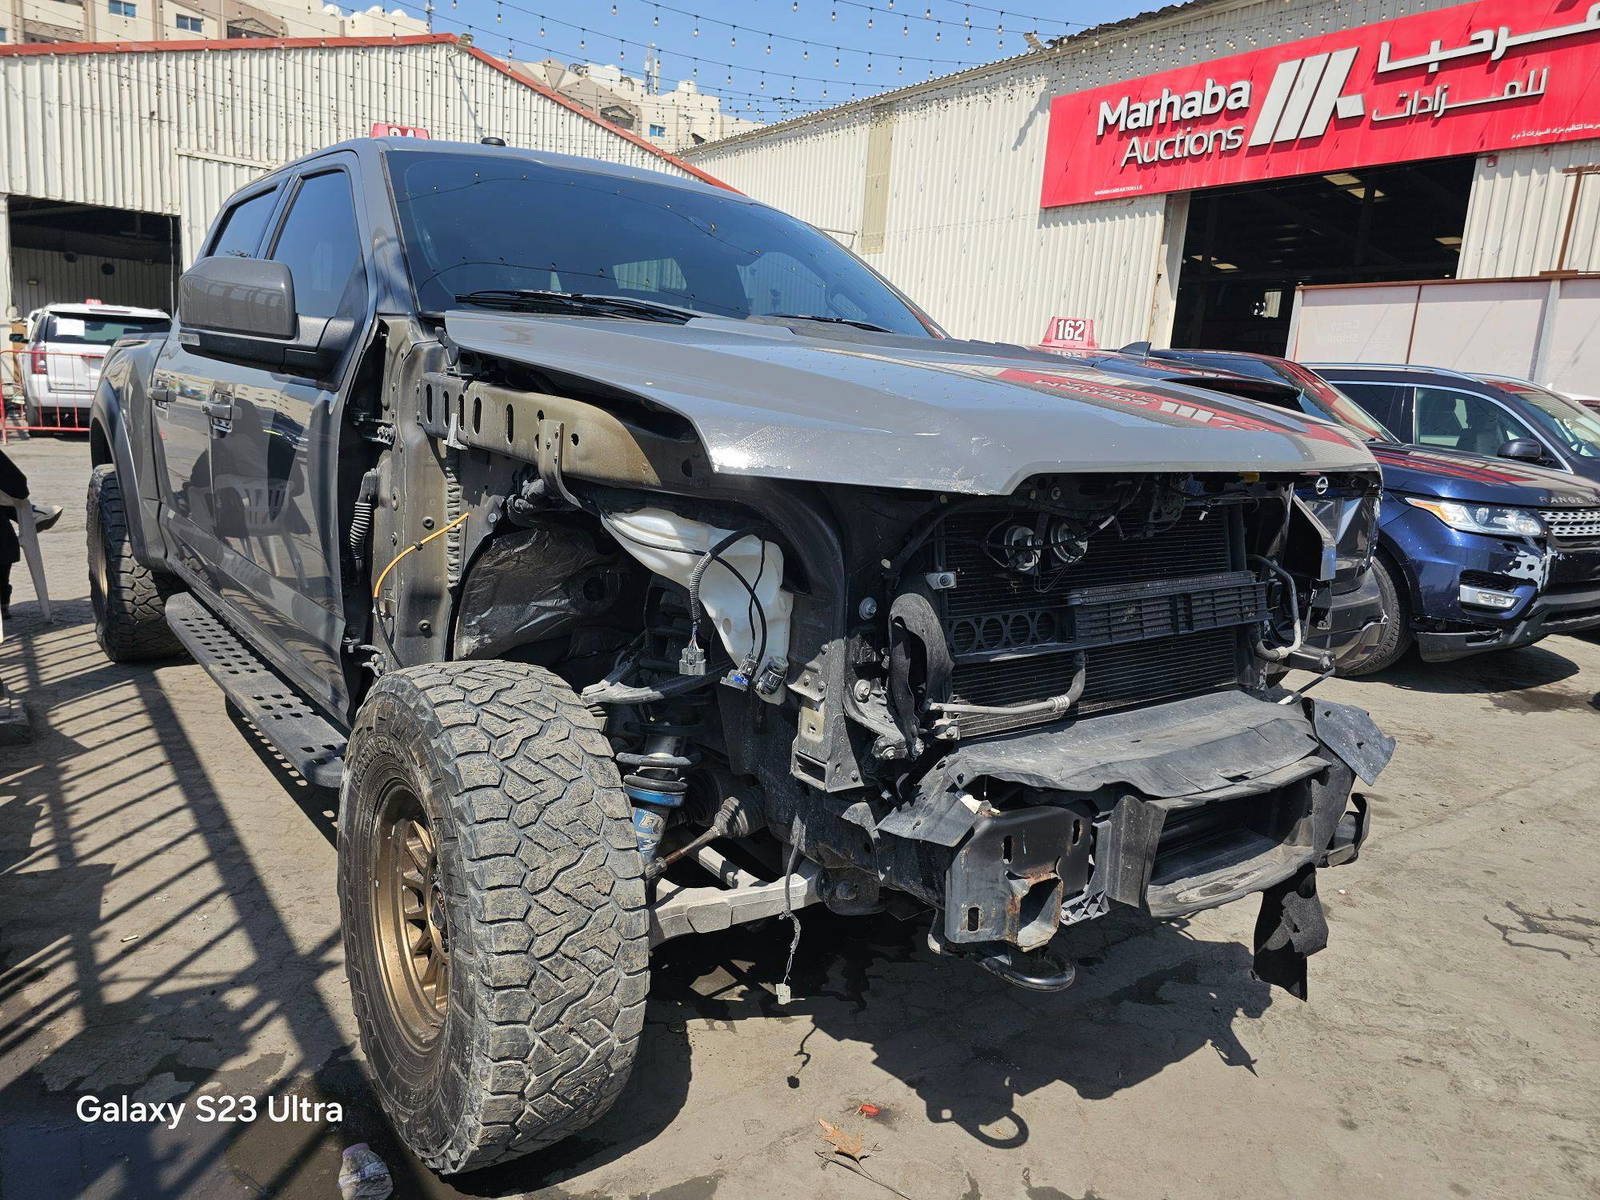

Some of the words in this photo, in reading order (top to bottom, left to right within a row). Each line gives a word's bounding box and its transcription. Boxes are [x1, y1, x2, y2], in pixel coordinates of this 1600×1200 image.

[1096, 78, 1252, 136] Marhaba
[1372, 67, 1548, 121] للمزادات
[1120, 125, 1246, 168] Auctions
[1057, 319, 1085, 341] 162
